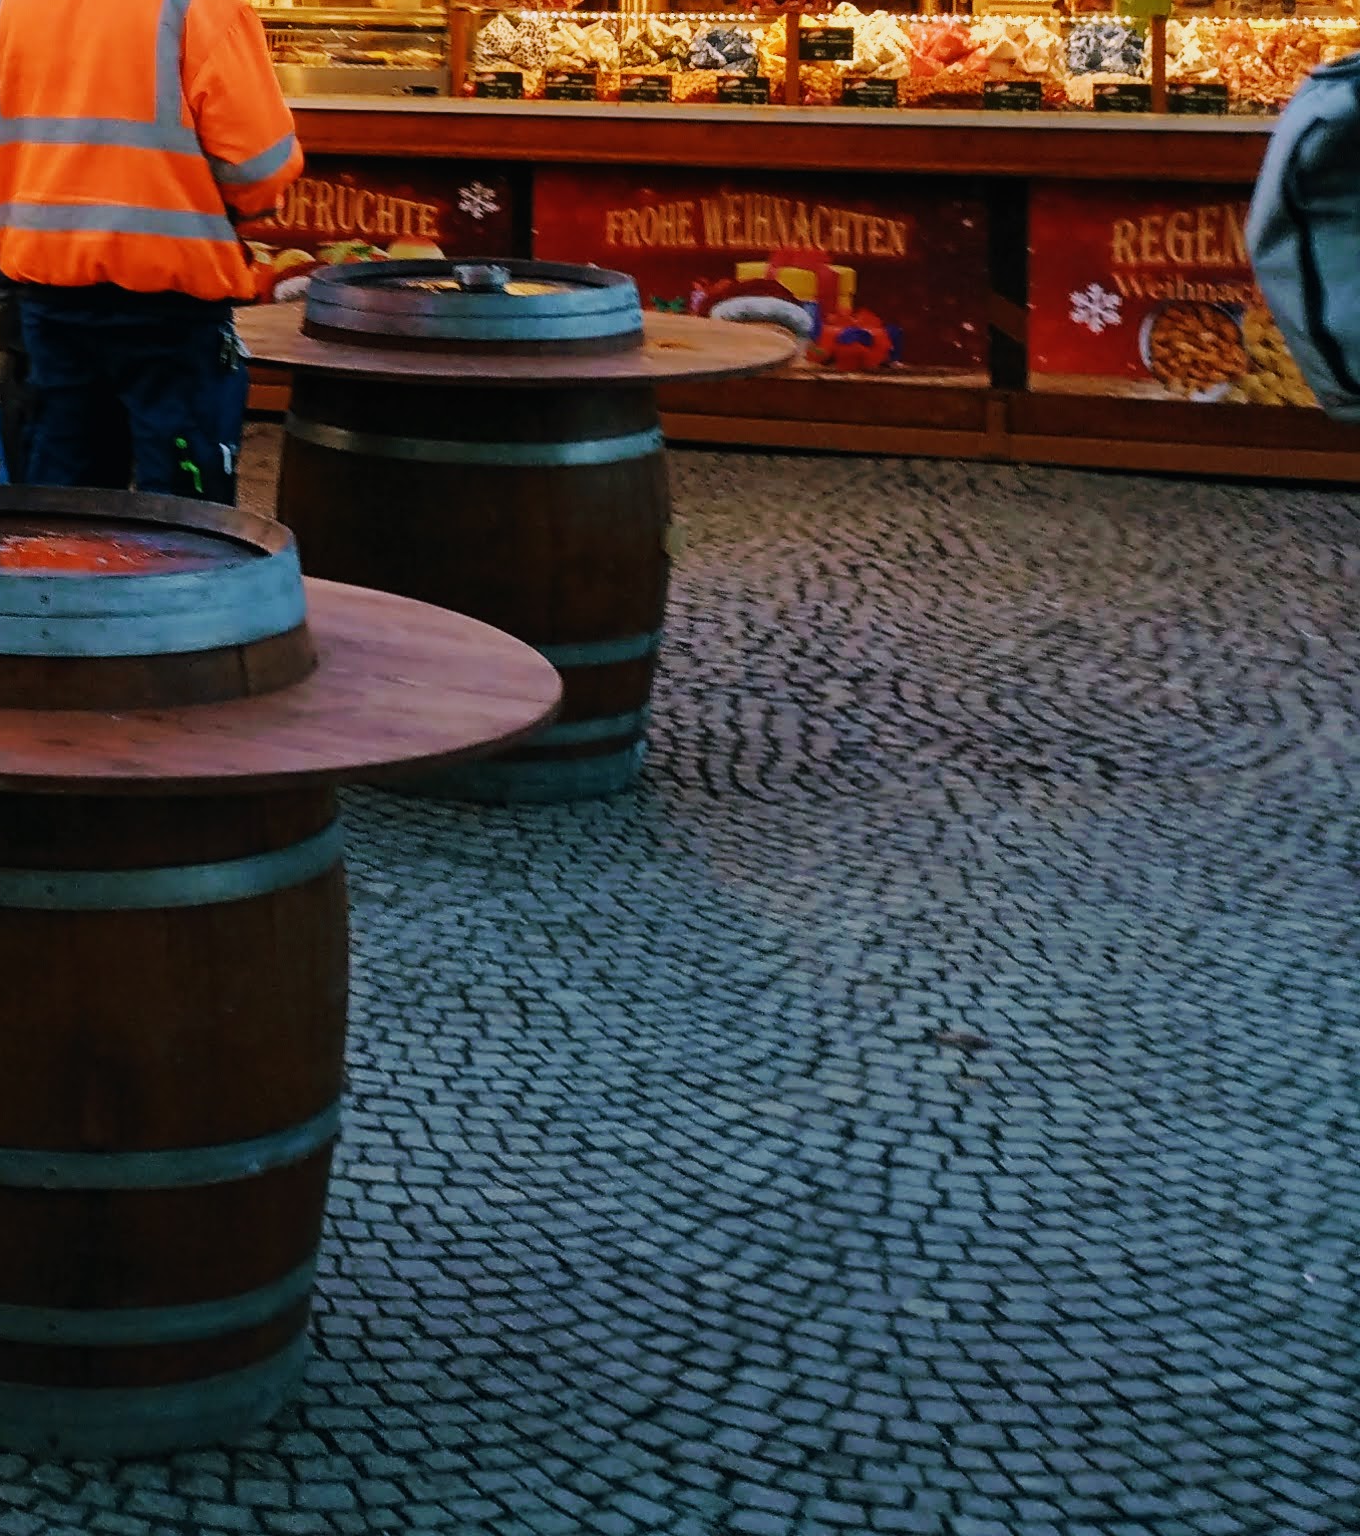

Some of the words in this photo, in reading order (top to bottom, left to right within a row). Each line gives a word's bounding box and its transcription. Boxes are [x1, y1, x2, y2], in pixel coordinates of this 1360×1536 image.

[265, 174, 440, 237] OFRÜCHTE
[606, 200, 696, 248] FROHE
[700, 186, 907, 257] WEIHNACHTEN
